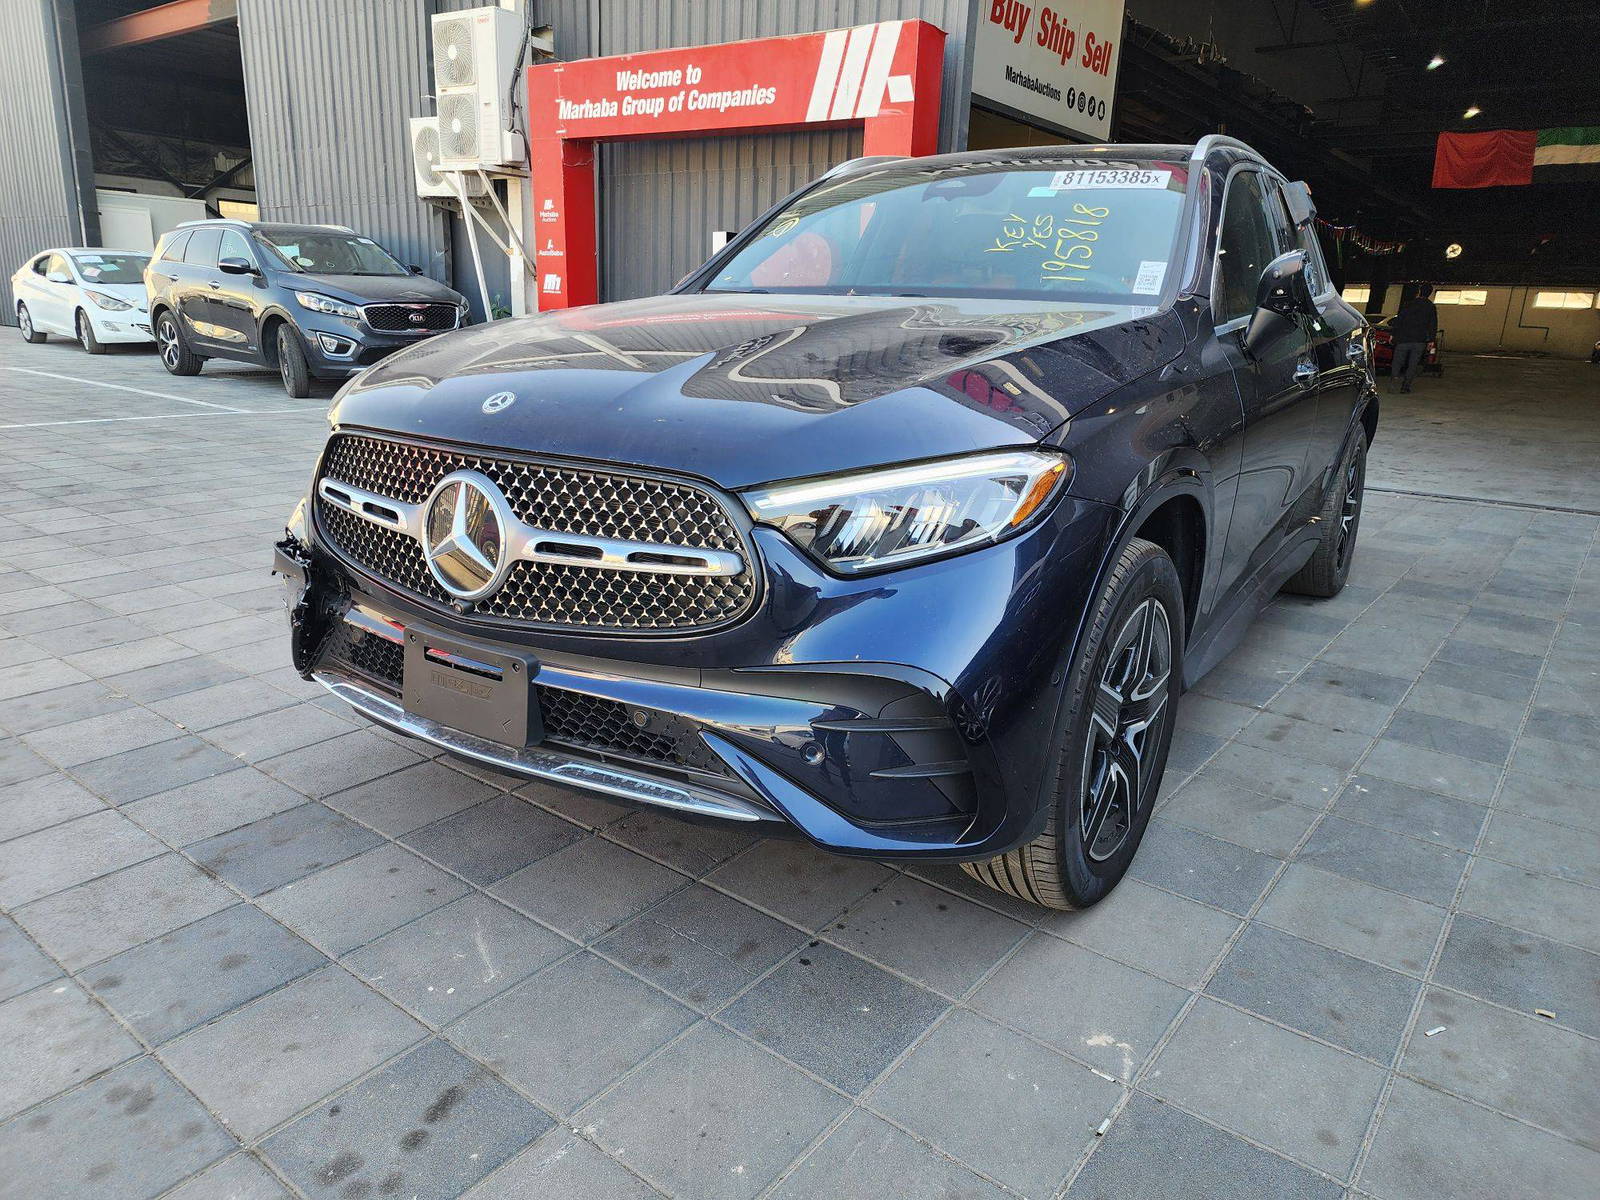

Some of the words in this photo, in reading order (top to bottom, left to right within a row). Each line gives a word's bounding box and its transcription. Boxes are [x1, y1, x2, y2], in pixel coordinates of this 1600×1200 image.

[990, 0, 1031, 44] Buy
[1037, 7, 1075, 66] Ship
[1082, 31, 1112, 77] Sell
[616, 69, 682, 91] Welcome
[686, 64, 702, 84] to
[1005, 65, 1061, 101] MarhabaAuctions
[558, 99, 618, 120] Marhaba
[622, 95, 664, 118] Group
[668, 91, 686, 113] of
[687, 84, 776, 112] Companies
[1041, 202, 1110, 281] 195818
